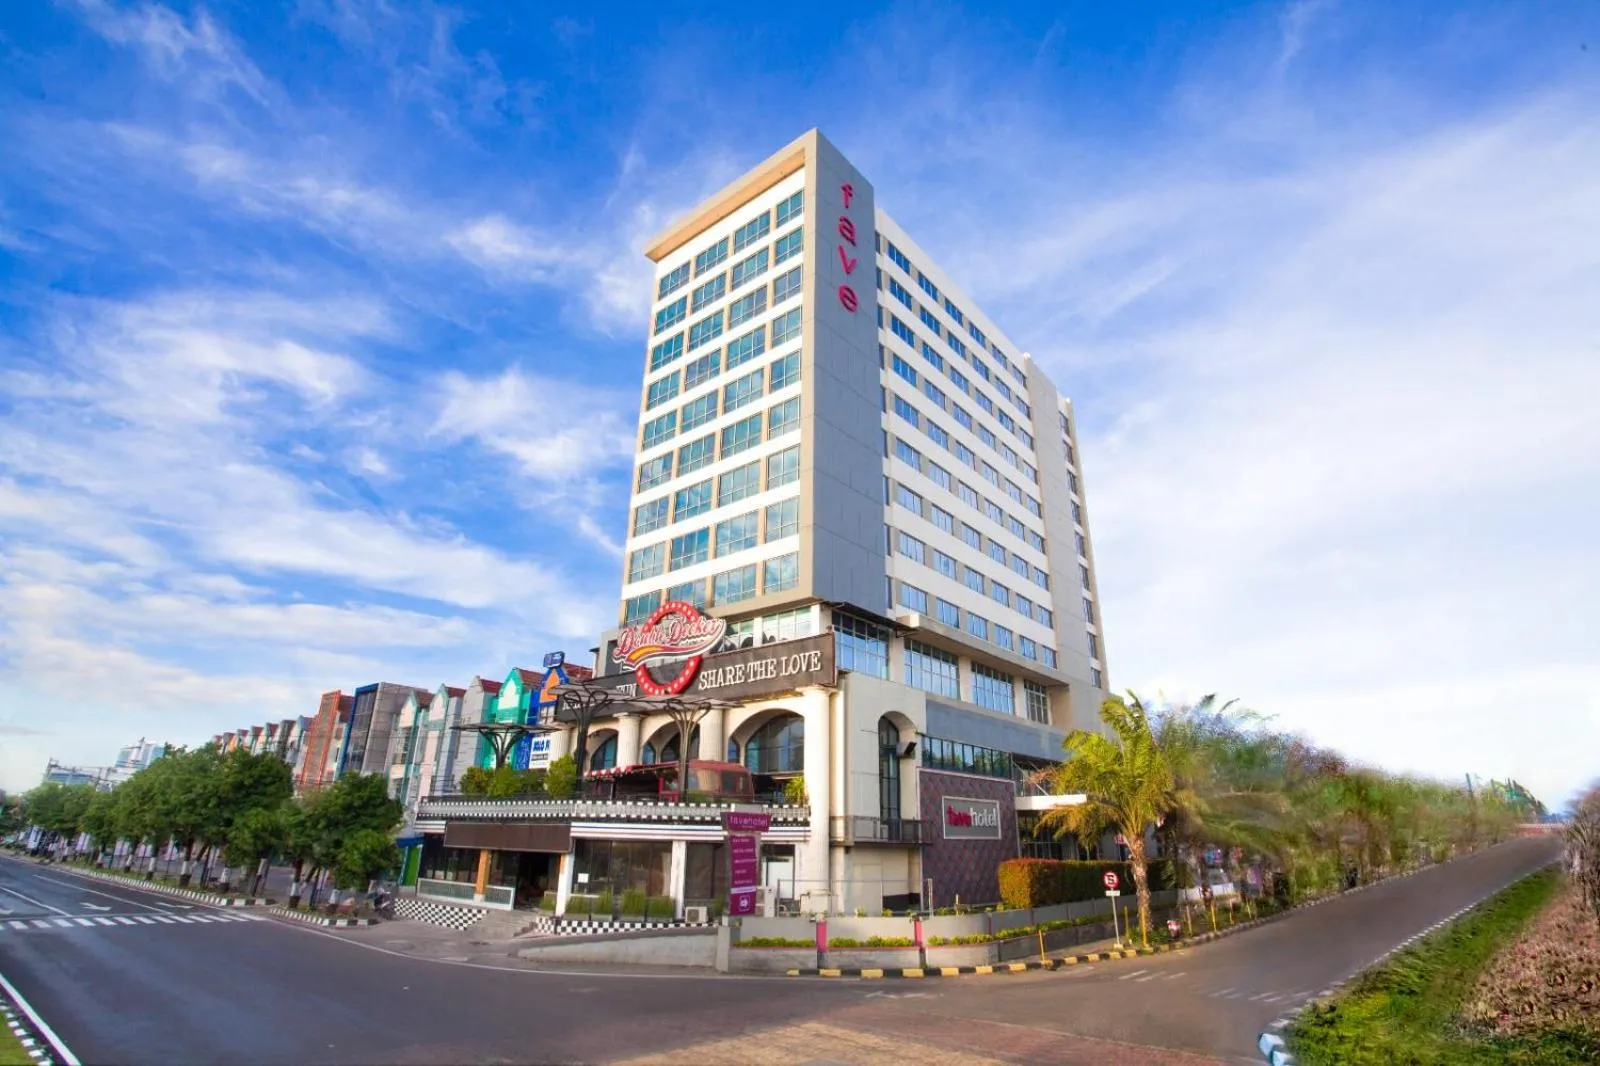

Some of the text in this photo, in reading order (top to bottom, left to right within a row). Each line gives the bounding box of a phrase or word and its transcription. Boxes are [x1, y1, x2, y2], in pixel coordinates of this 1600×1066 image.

[837, 183, 858, 313] fave
[698, 650, 822, 691] SHARE THE LOVE
